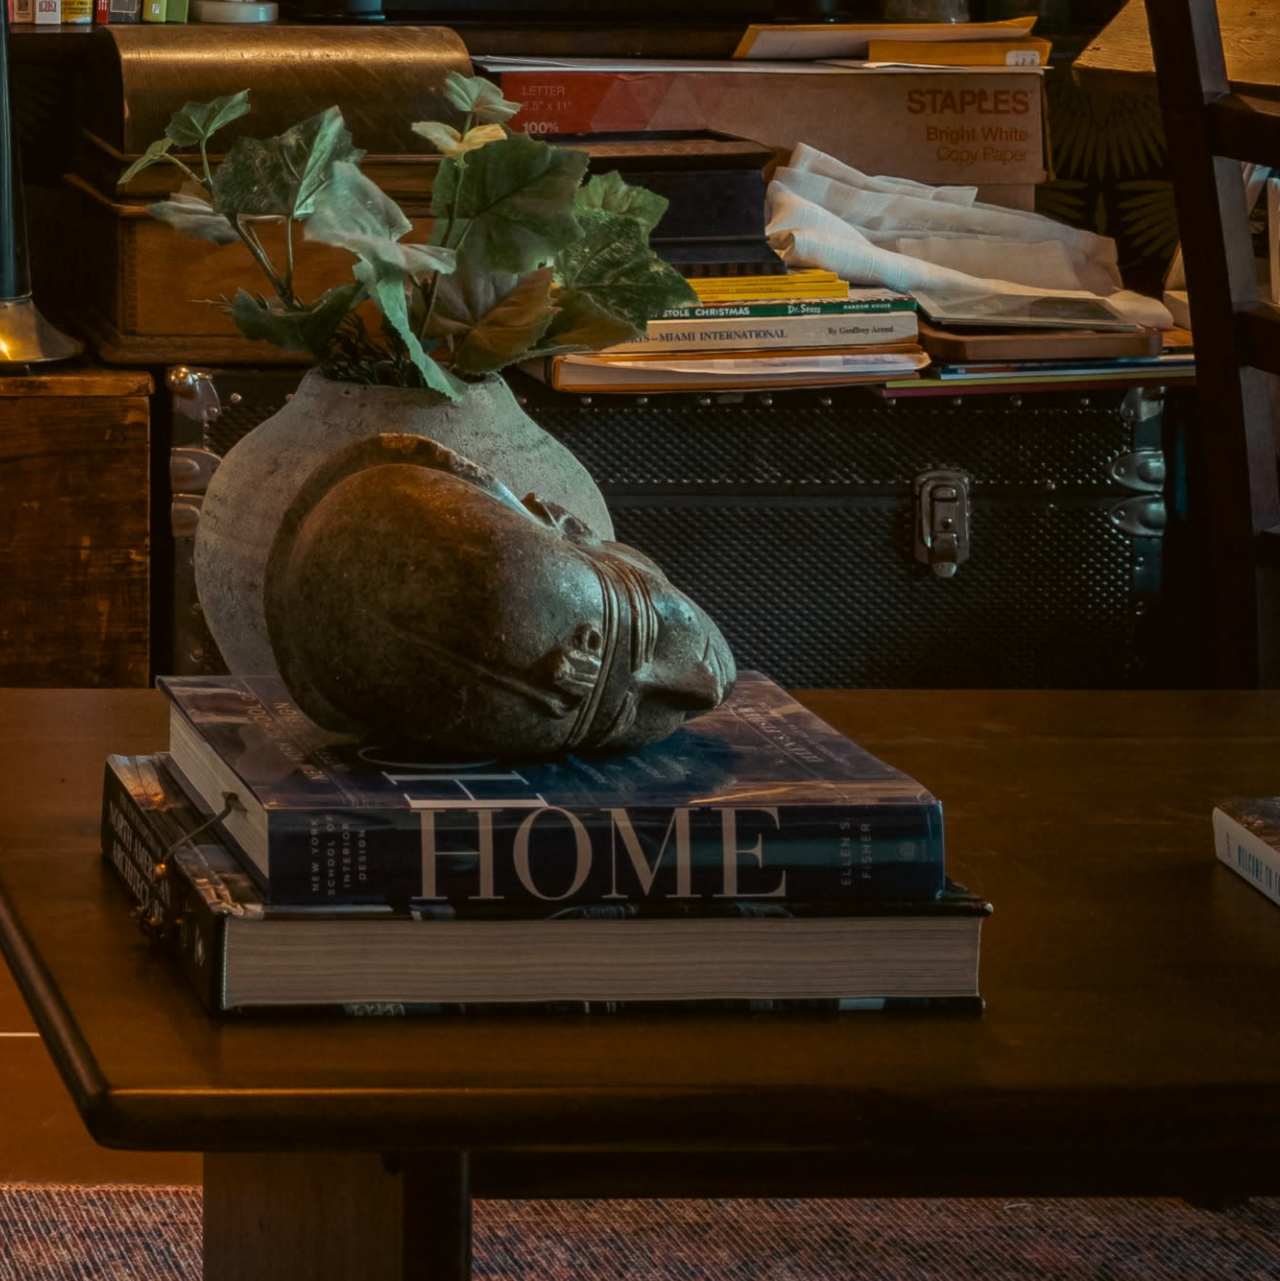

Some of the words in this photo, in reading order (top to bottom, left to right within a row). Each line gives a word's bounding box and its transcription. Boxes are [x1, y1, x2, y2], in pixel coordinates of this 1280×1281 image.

[521, 85, 566, 97] LETTER
[905, 88, 1031, 116] STAPLES
[521, 120, 559, 134] 100%
[924, 125, 979, 144] Bright
[980, 125, 1028, 142] White
[984, 146, 1028, 166] Paper
[695, 306, 751, 317] CHRISTMAS
[699, 328, 789, 341] INTERNATIONAL
[341, 822, 352, 889] INTERIOR
[357, 828, 368, 882] DESIGN
[408, 806, 788, 902] HOME
[839, 836, 851, 887] ELLEN
[859, 822, 872, 880] FISHER
[309, 861, 320, 893] NEW
[326, 838, 337, 897] SCHOOL
